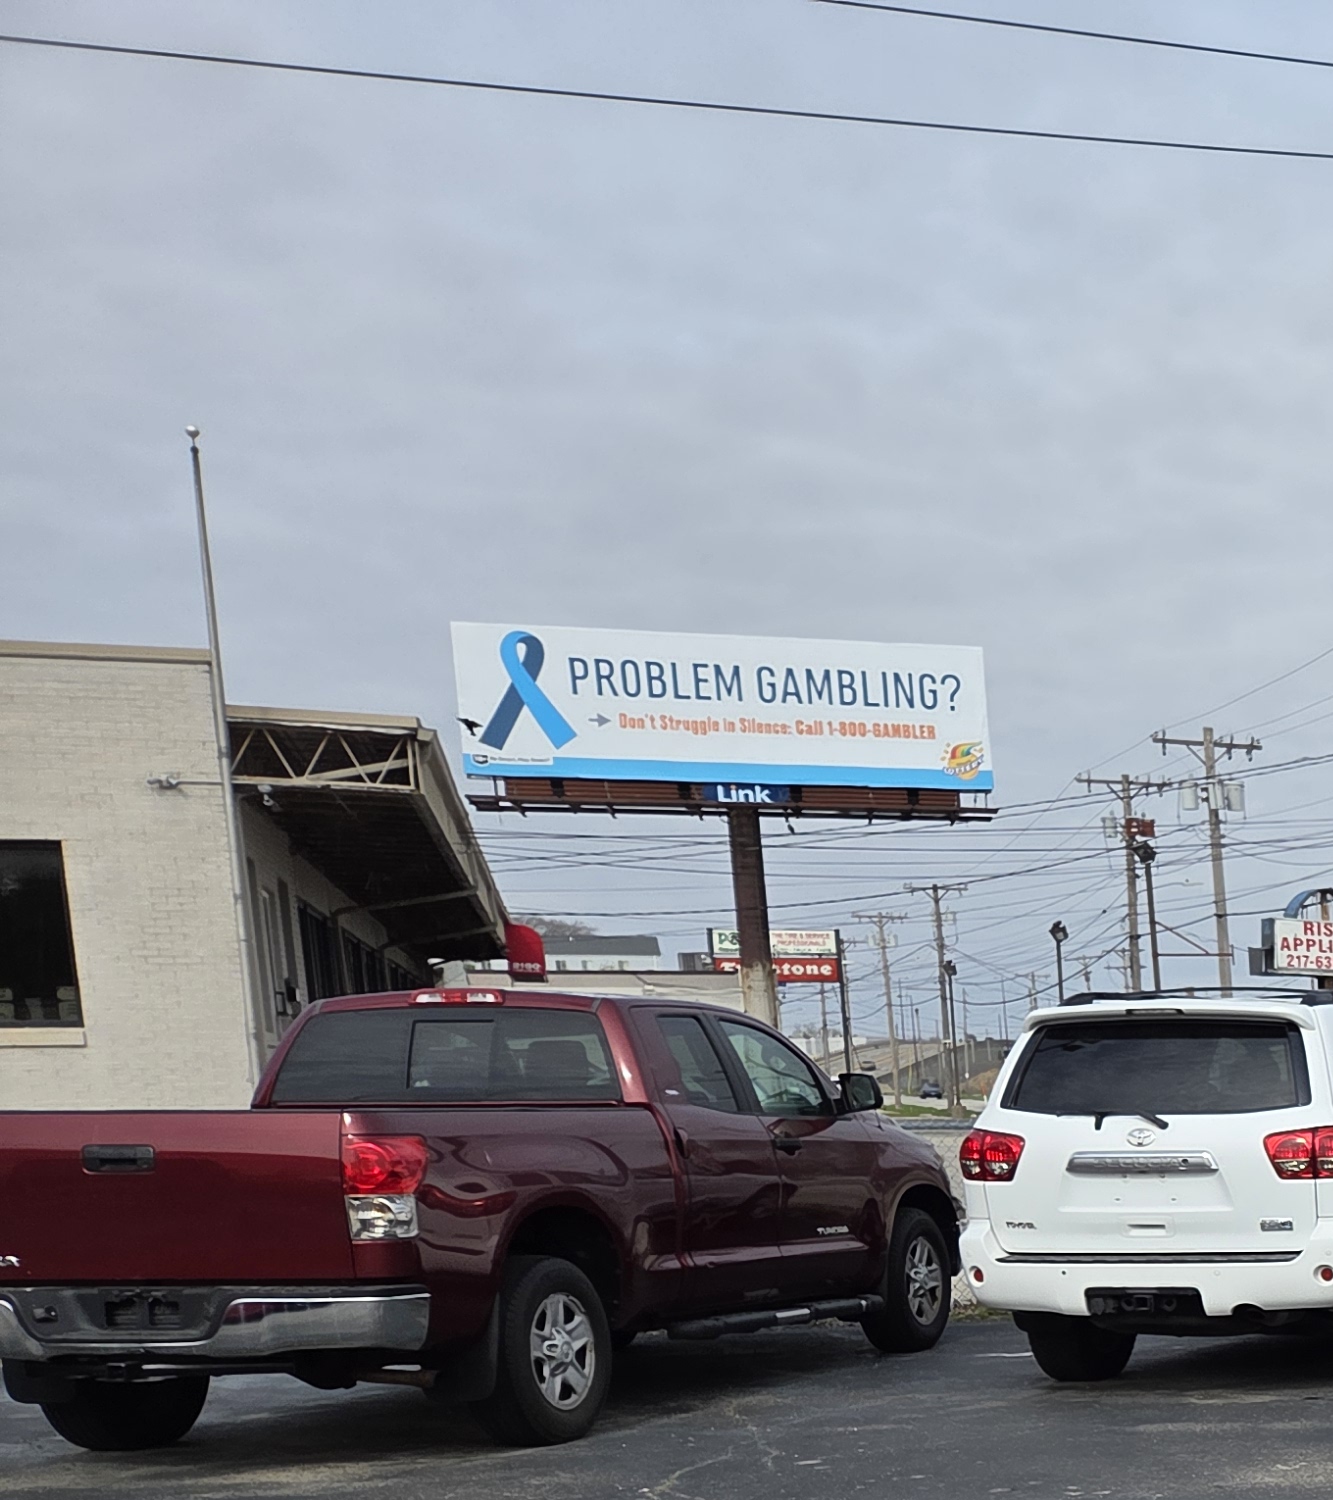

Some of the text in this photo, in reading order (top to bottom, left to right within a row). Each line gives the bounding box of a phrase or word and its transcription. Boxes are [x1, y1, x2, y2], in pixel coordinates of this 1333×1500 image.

[568, 657, 961, 711] PROBLEM GAMBLING?
[618, 712, 656, 730] Don't
[659, 714, 720, 735] Struggle
[723, 718, 736, 733] in
[795, 720, 824, 736] Call
[827, 721, 936, 740] 1-800-GAMBLER
[716, 784, 775, 804] Link
